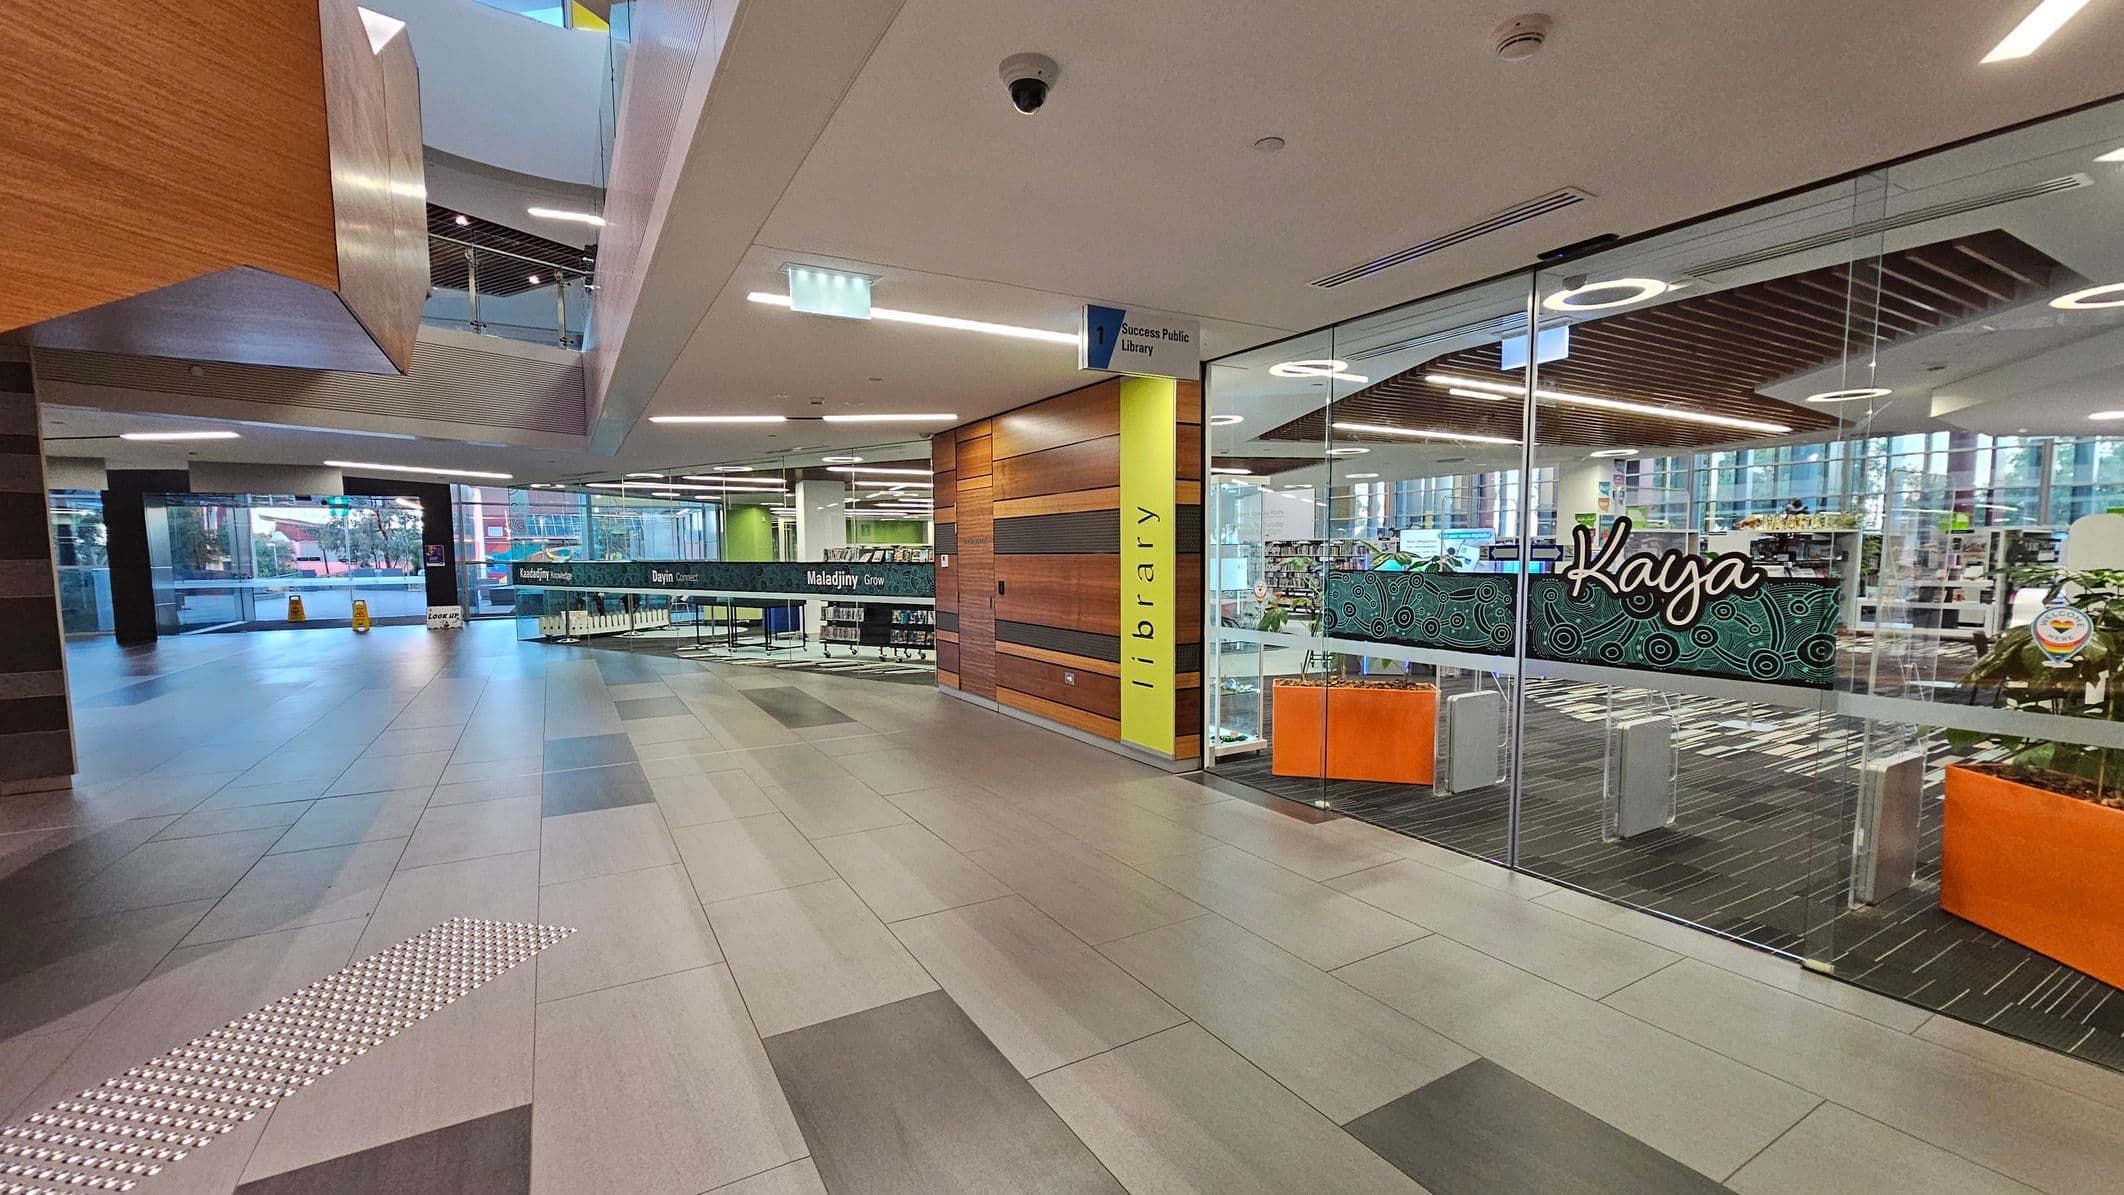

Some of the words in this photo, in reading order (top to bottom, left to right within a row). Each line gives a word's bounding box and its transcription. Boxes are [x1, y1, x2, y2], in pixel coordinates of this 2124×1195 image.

[1096, 325, 1104, 345] 1
[1121, 323, 1160, 339] Success
[1162, 328, 1190, 343] Public
[1121, 339, 1153, 357] Library
[652, 569, 673, 586] Dayin
[675, 572, 698, 582] Connect
[807, 570, 858, 590] Maladjiny
[864, 574, 885, 586] Grow
[1566, 520, 1762, 627] Kaya
[1131, 506, 1160, 688] library
[2039, 610, 2085, 628] WELCOME
[2047, 633, 2074, 641] HERE
